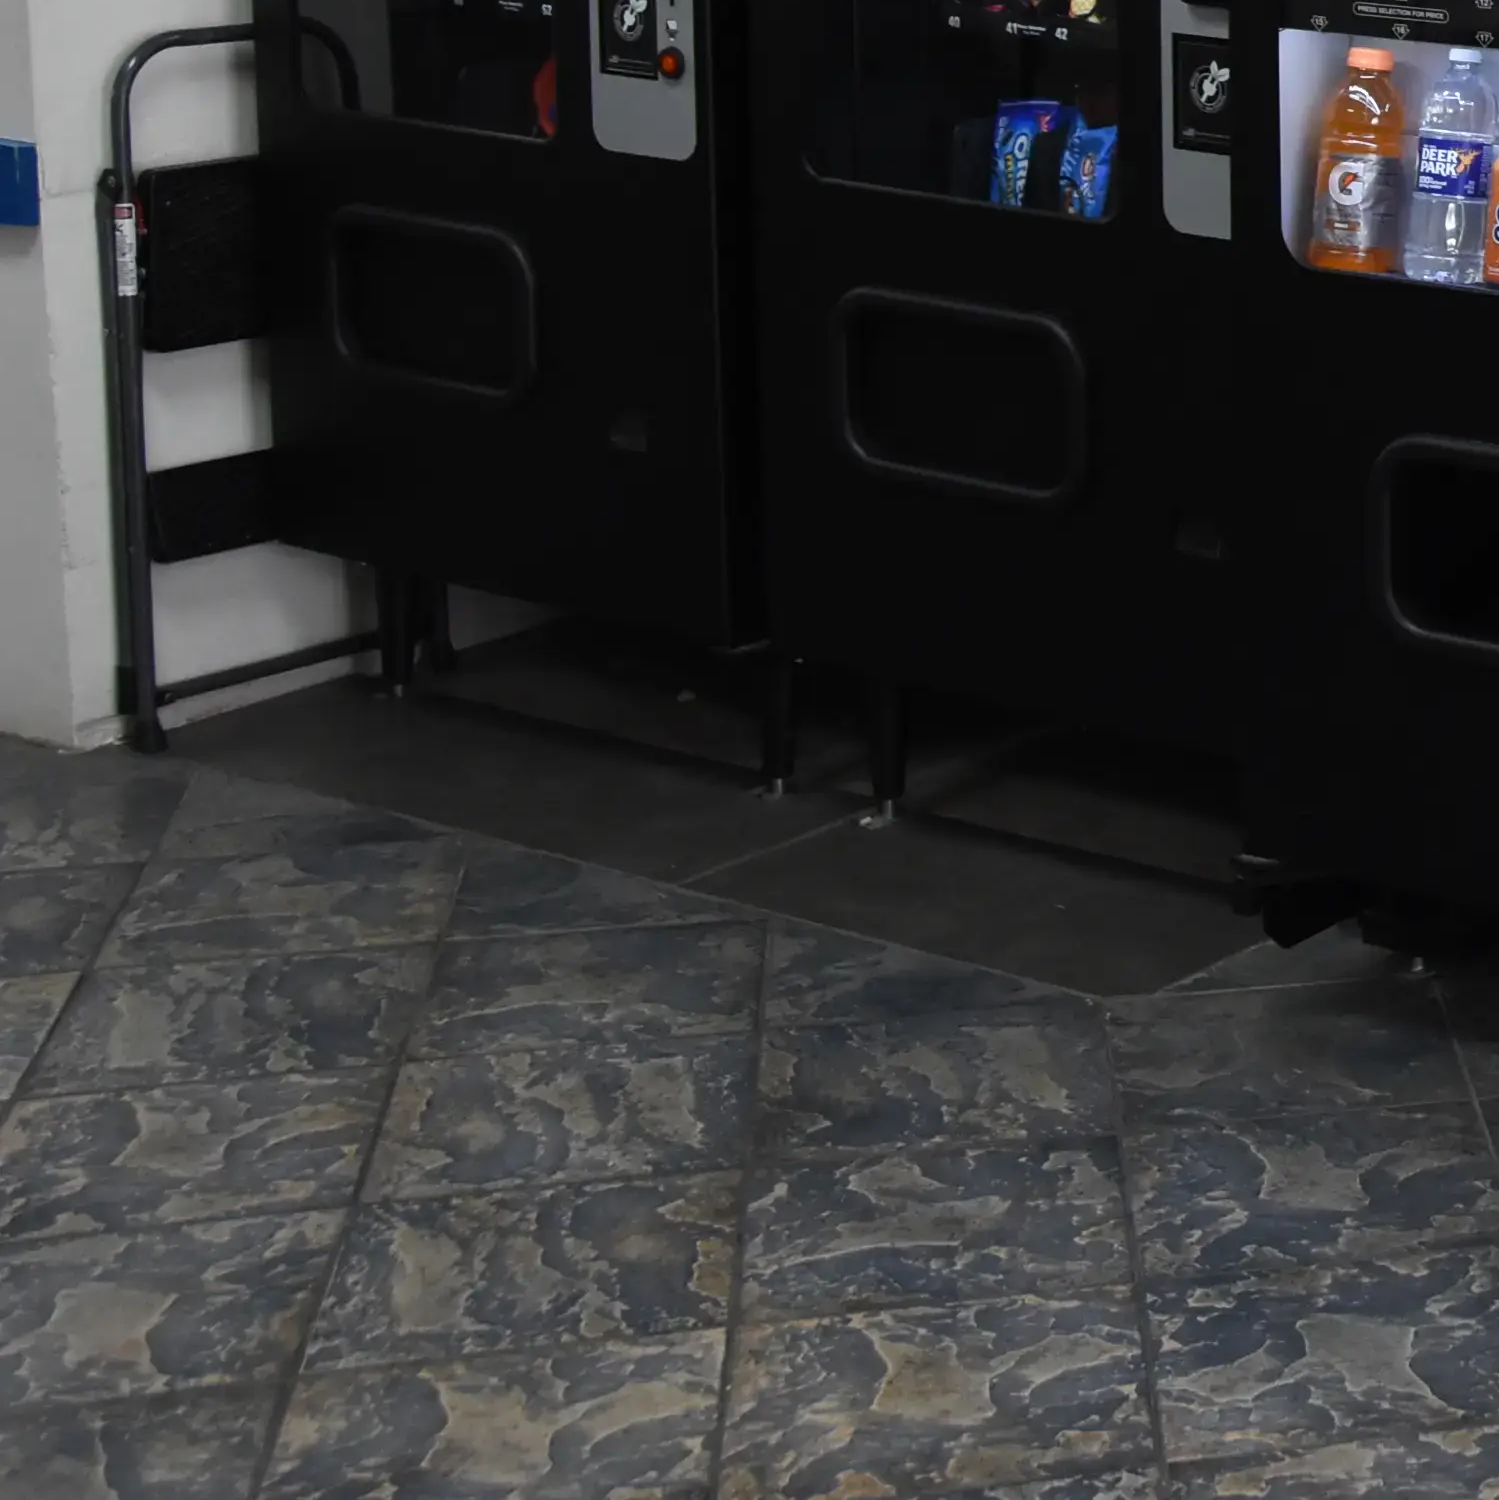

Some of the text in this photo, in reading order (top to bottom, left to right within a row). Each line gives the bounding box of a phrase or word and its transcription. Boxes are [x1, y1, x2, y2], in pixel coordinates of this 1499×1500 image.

[1421, 147, 1459, 164] DEER
[1420, 160, 1458, 177] PARK
[1328, 161, 1367, 206] G
